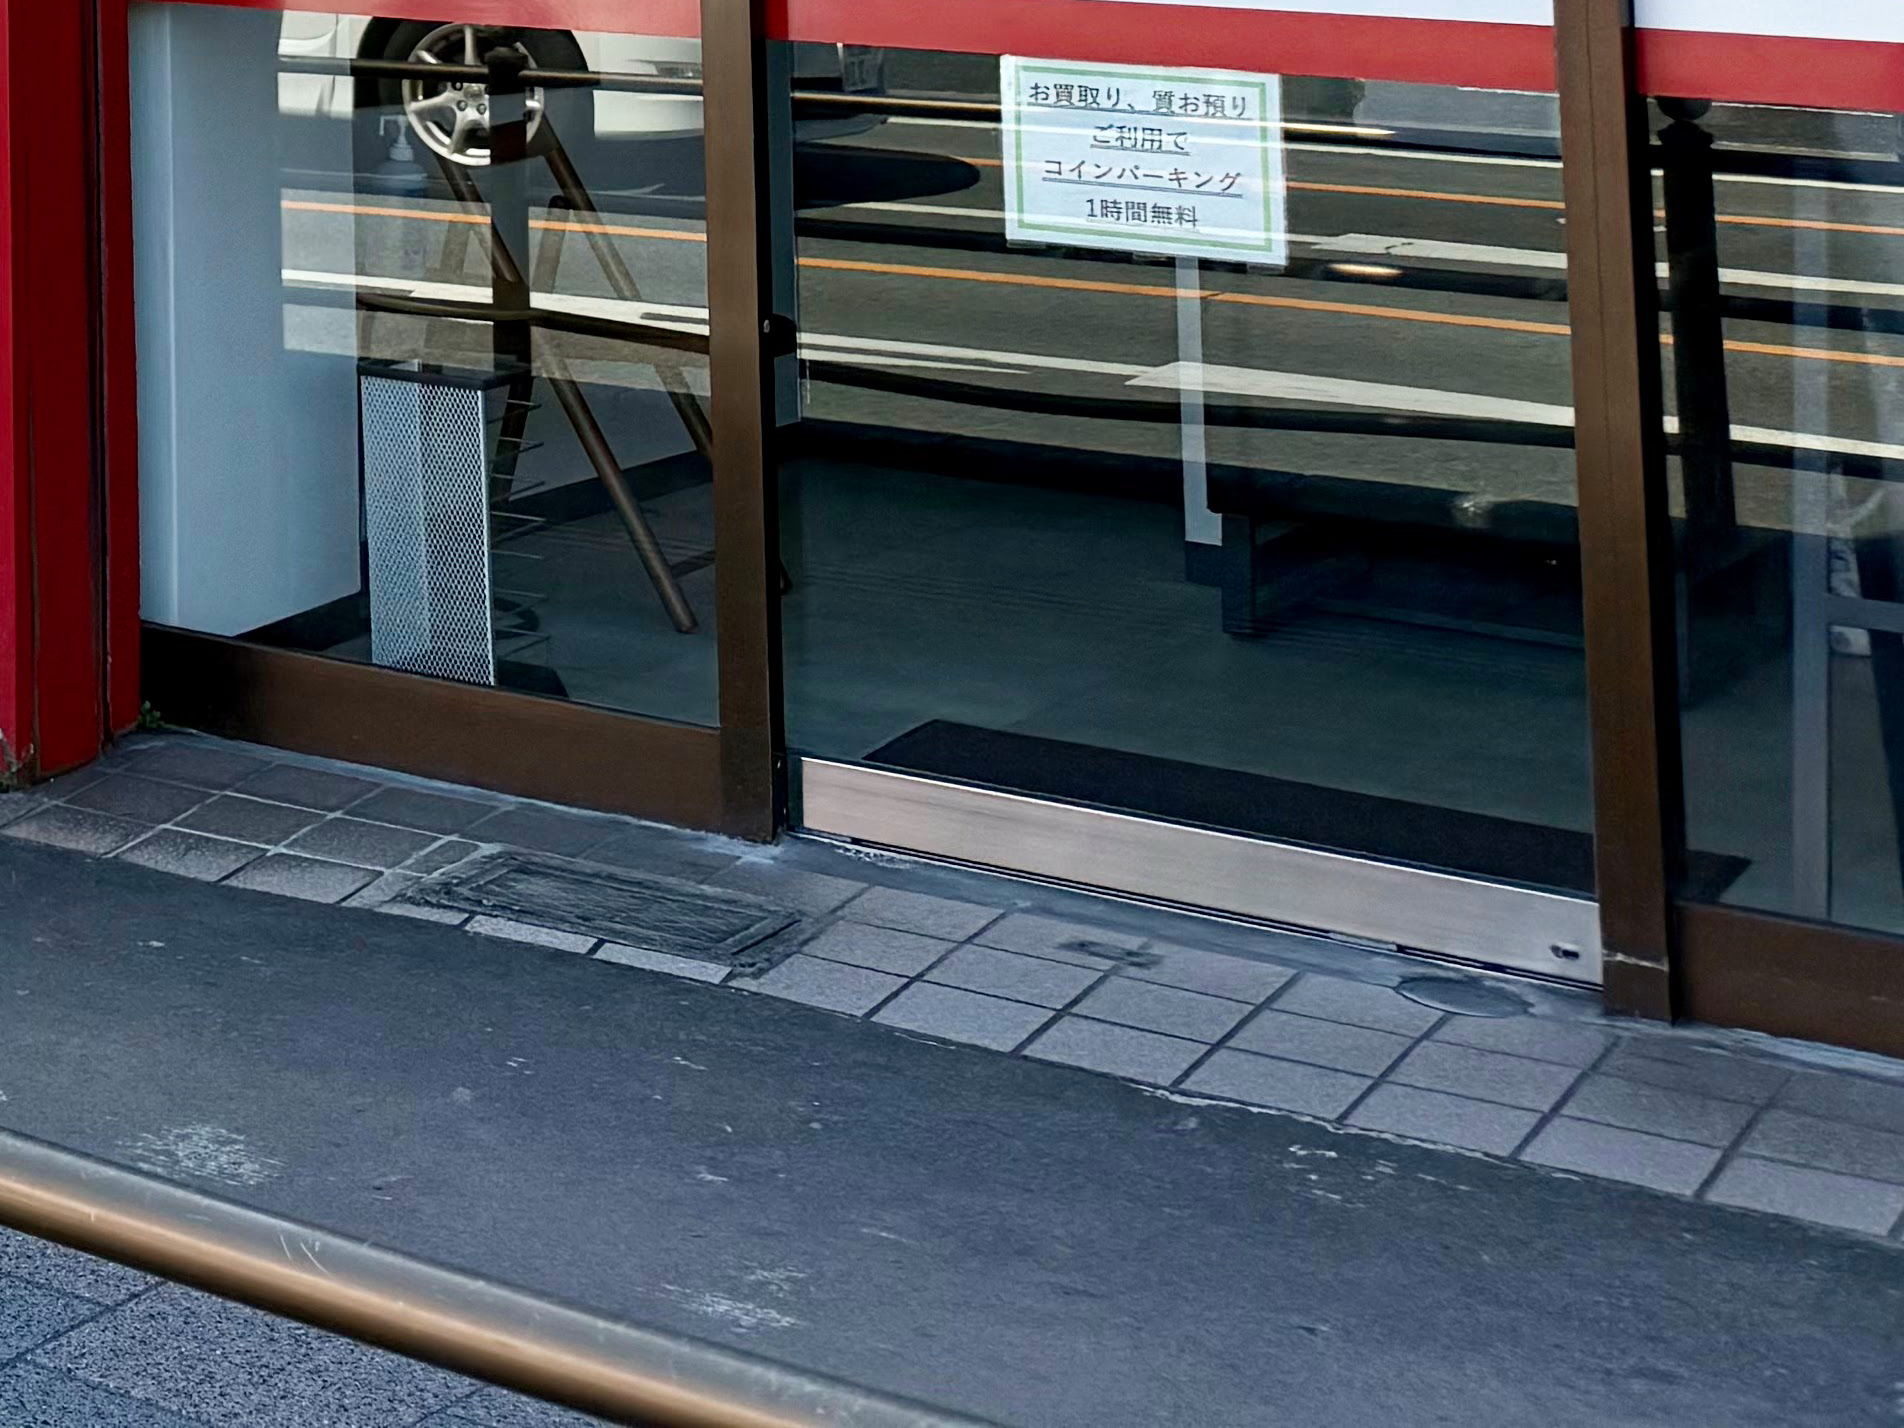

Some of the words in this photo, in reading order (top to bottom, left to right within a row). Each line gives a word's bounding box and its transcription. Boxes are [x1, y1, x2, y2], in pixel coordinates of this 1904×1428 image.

[1029, 82, 1248, 118] お買取り、質お預り
[1044, 159, 1242, 192] コインパーキング
[1085, 197, 1199, 228] 1時間無料
